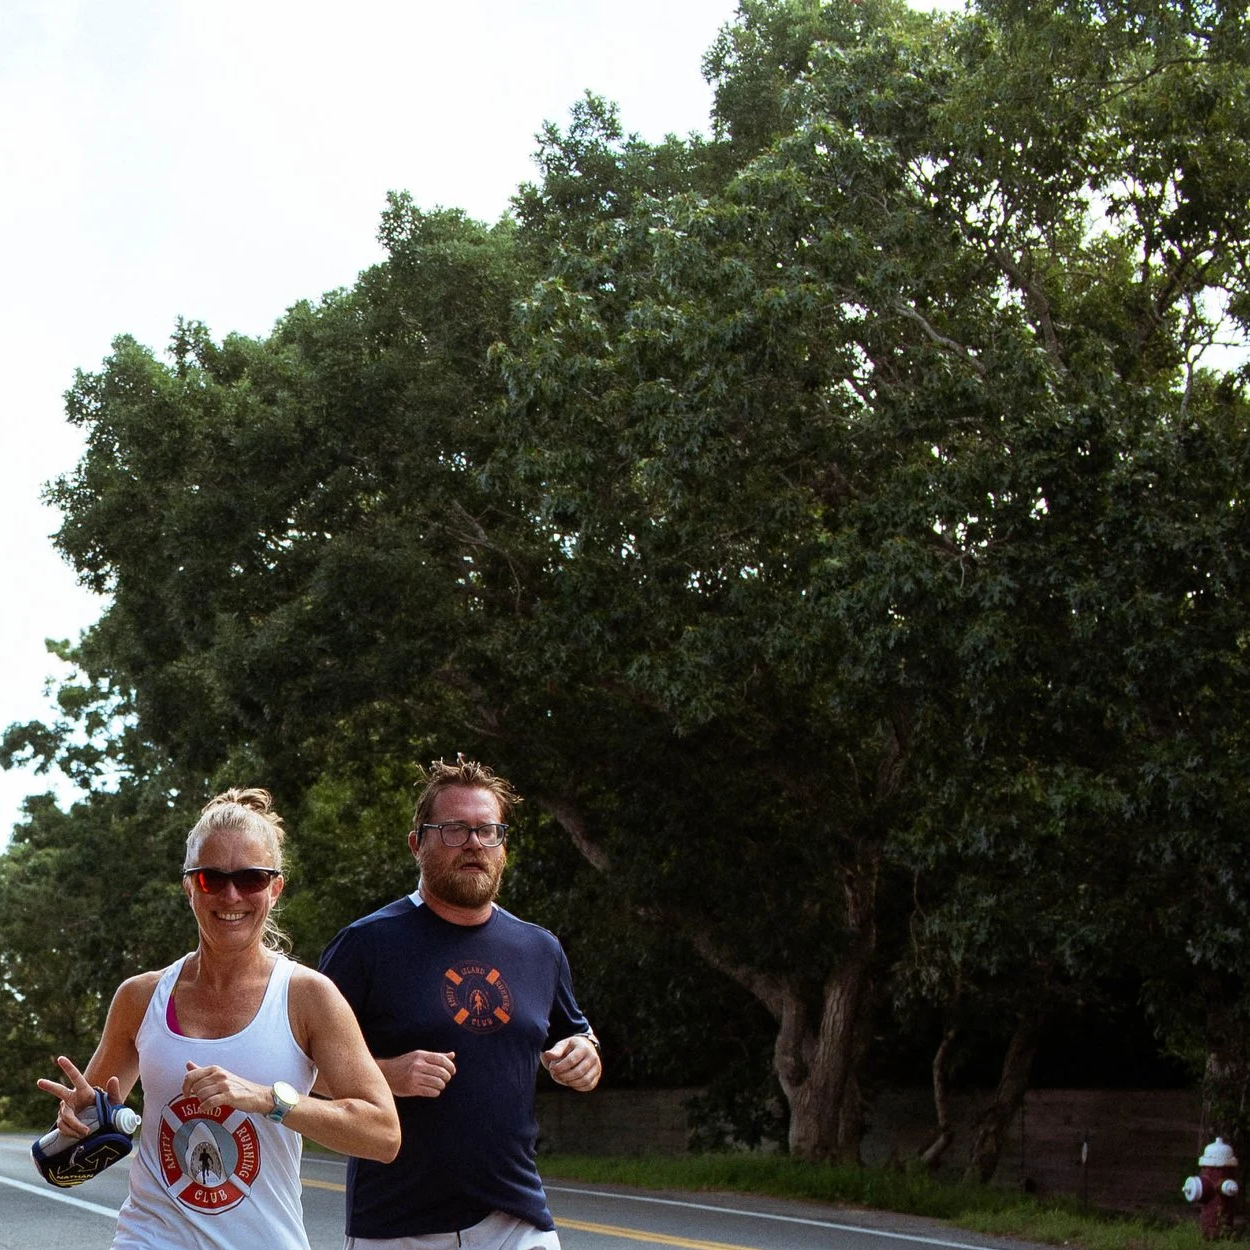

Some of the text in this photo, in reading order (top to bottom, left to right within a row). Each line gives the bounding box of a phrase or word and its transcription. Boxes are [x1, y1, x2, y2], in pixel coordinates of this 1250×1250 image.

[162, 1131, 176, 1169] AMITY
[236, 1126, 255, 1178] RUNNING
[194, 1189, 228, 1203] CLUB
